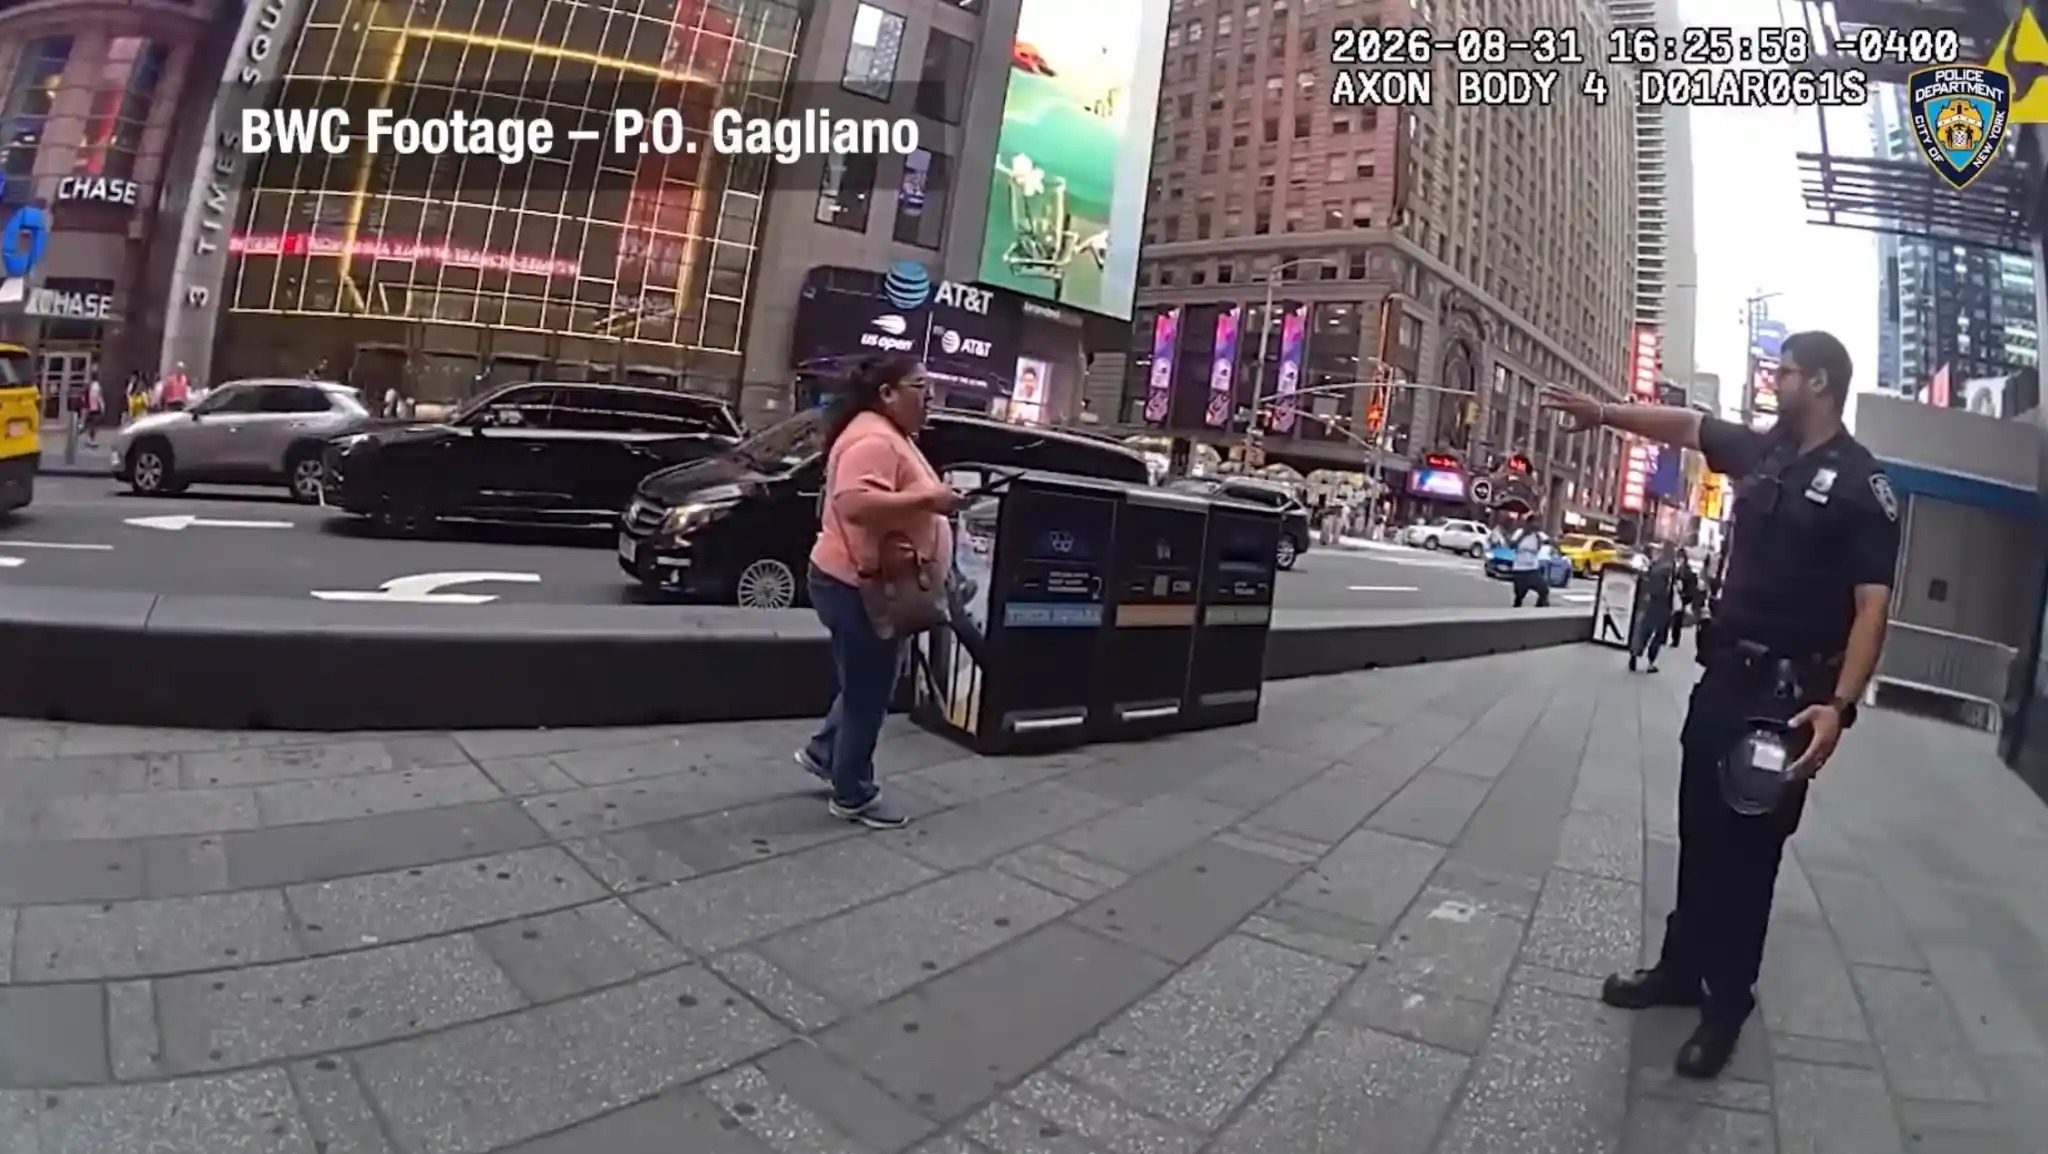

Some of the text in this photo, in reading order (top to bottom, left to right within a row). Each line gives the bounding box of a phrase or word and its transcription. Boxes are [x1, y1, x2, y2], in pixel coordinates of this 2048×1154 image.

[187, 0, 286, 307] 3 TIMES SQU
[58, 176, 137, 204] CHASE
[40, 288, 113, 319] CHASE
[934, 281, 994, 316] AT&T
[878, 336, 913, 351] open
[961, 338, 992, 357] AT&T
